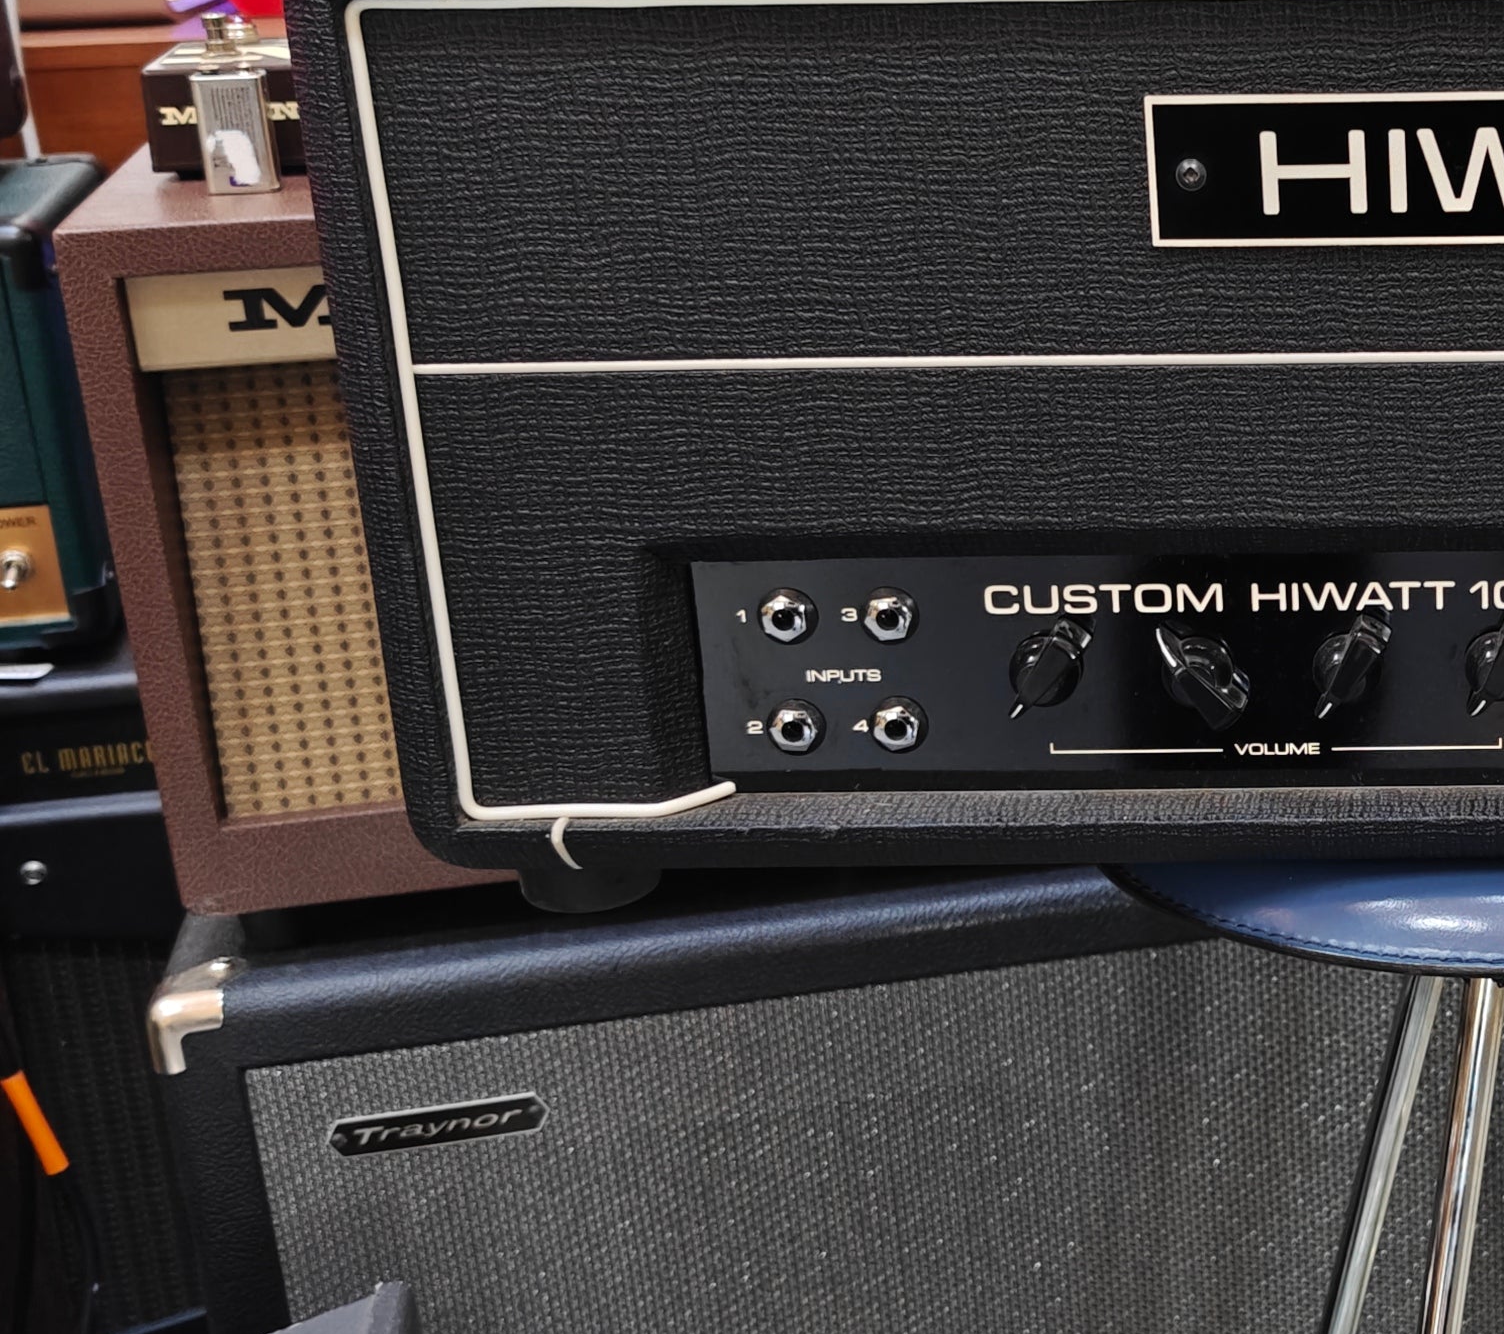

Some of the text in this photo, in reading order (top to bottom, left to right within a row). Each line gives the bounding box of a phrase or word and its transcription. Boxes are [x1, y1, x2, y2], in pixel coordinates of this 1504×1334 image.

[983, 583, 1224, 615] CUSTOM
[1250, 580, 1456, 613] HIWATT
[736, 609, 747, 624] 1
[840, 608, 858, 622] 3
[805, 669, 882, 683] INPUTS
[746, 720, 764, 735] 2
[852, 719, 869, 733] 4
[1233, 742, 1321, 757] VOLUME
[353, 1108, 523, 1146] Traynor
